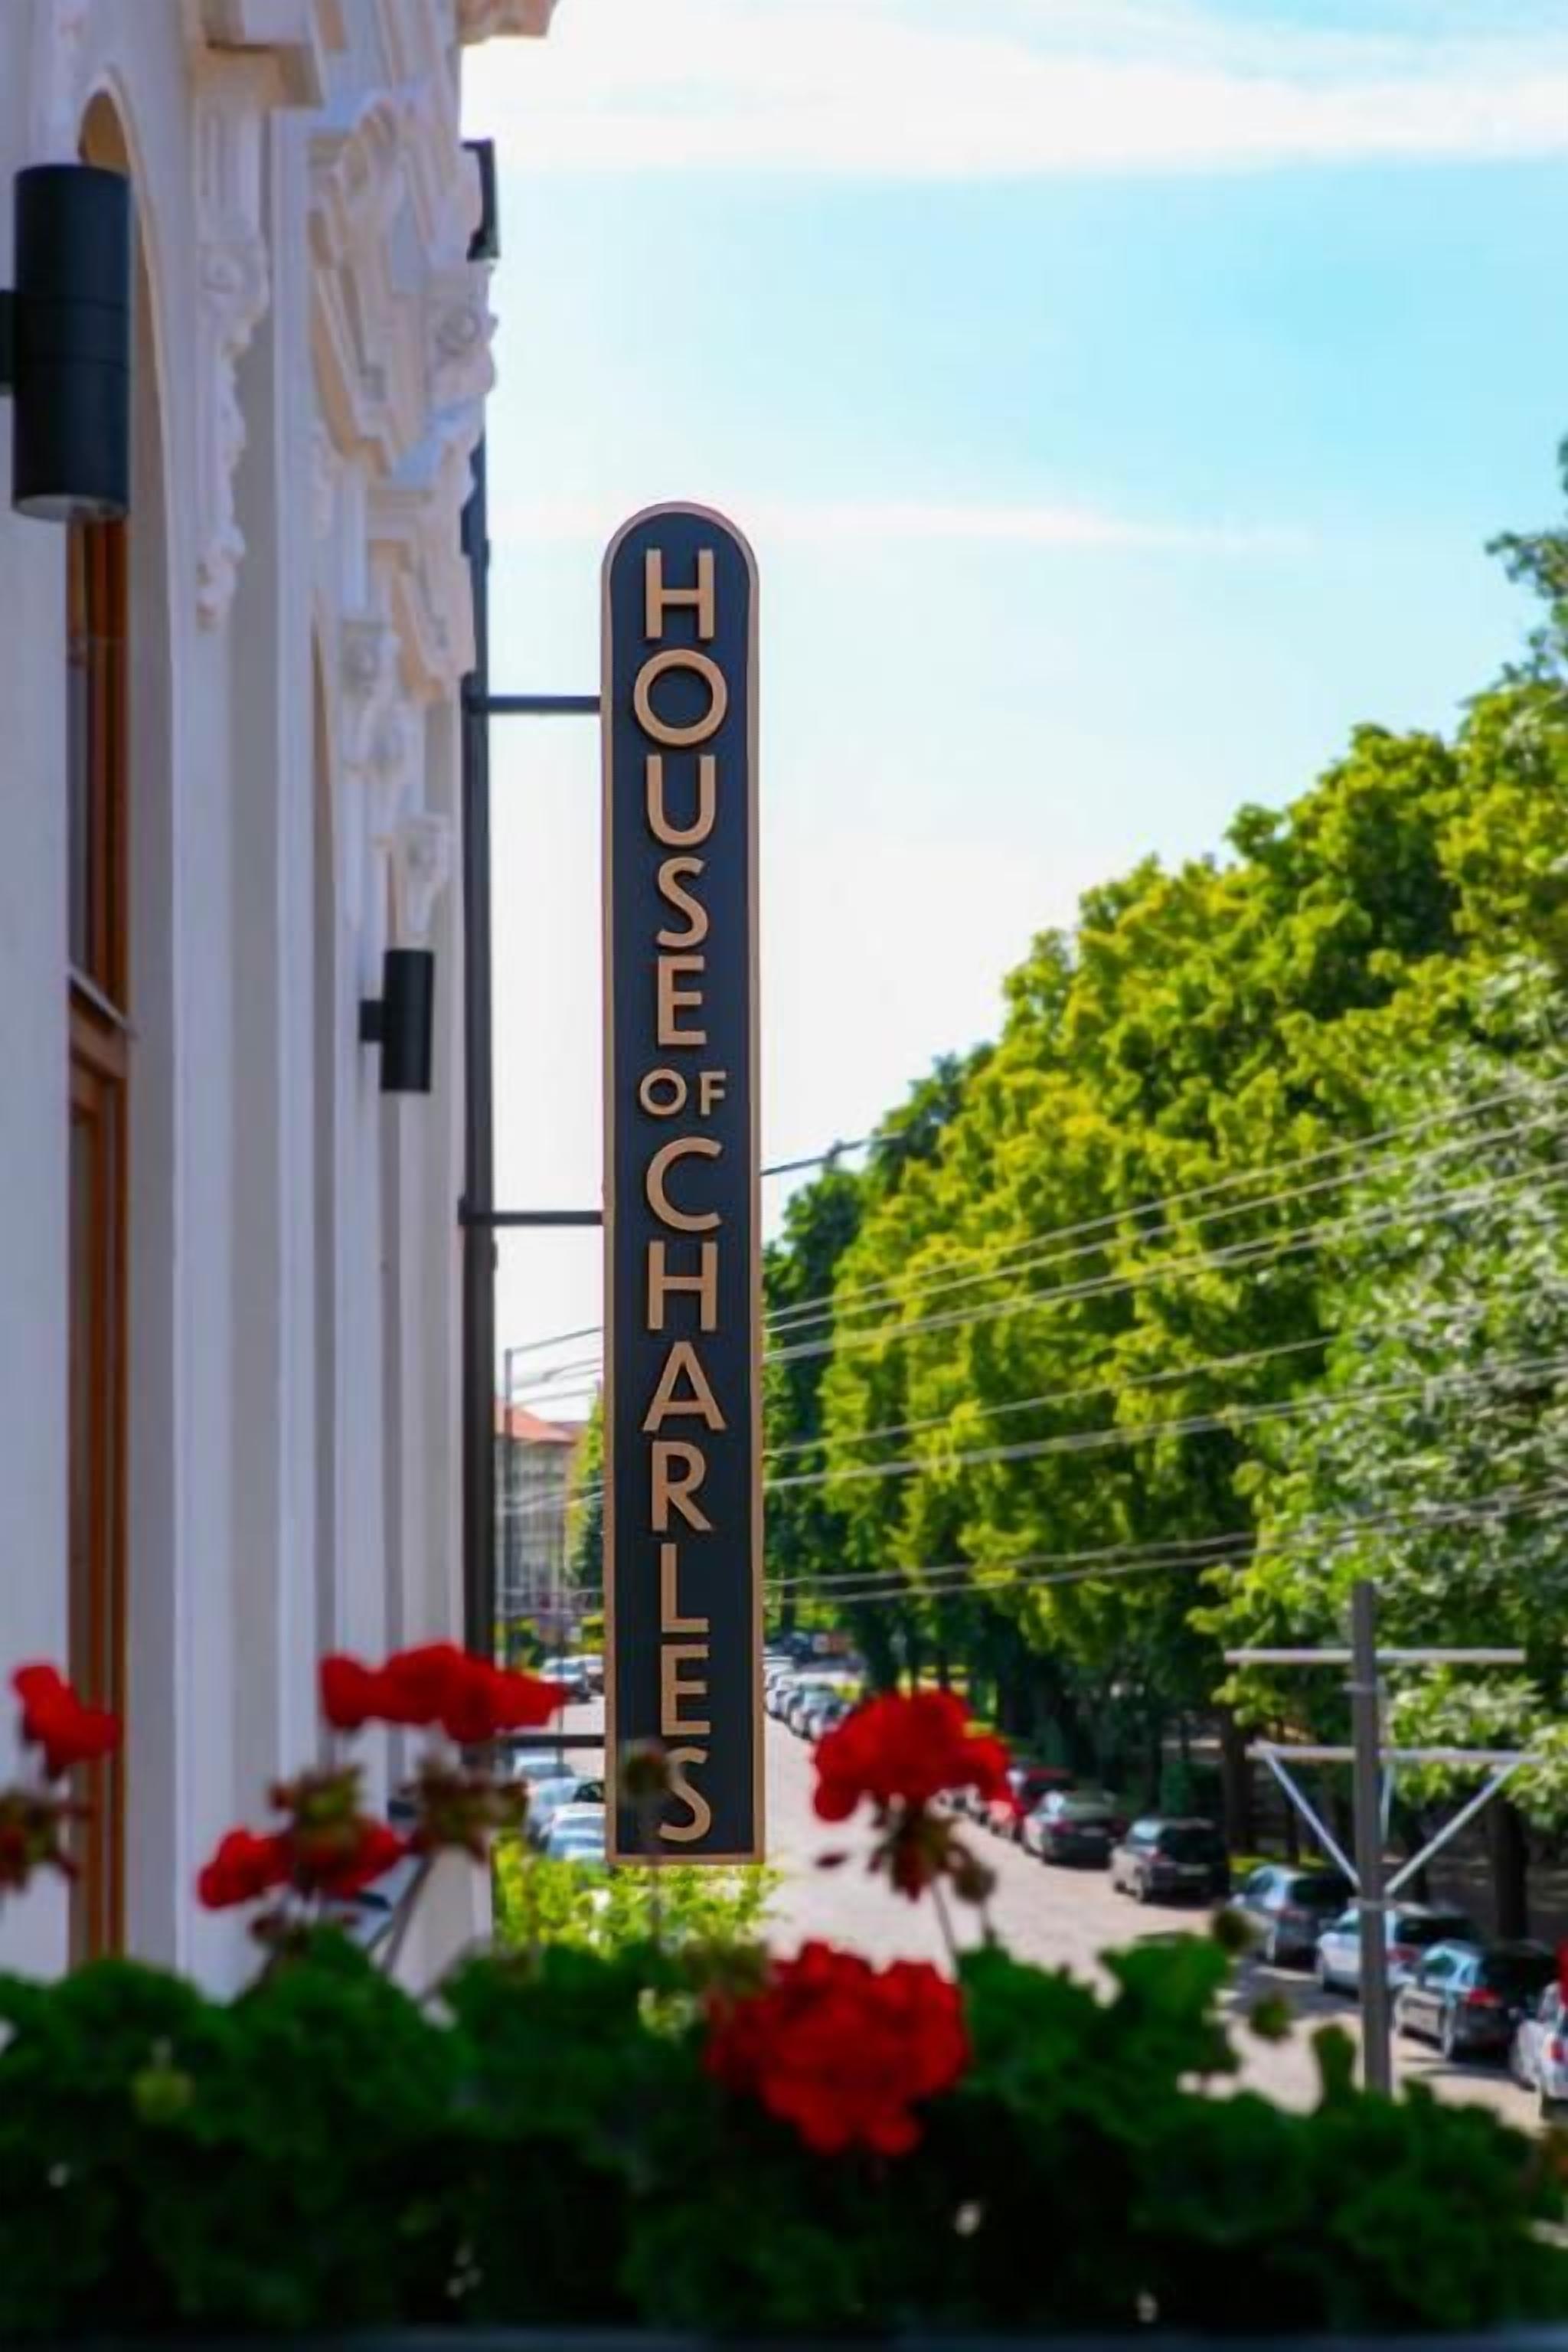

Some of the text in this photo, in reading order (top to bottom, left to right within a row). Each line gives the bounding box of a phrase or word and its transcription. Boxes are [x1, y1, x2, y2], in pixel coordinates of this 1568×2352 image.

[633, 548, 728, 1046] HOUSE
[639, 1069, 727, 1116] OF
[642, 1136, 727, 1841] CHARLES
